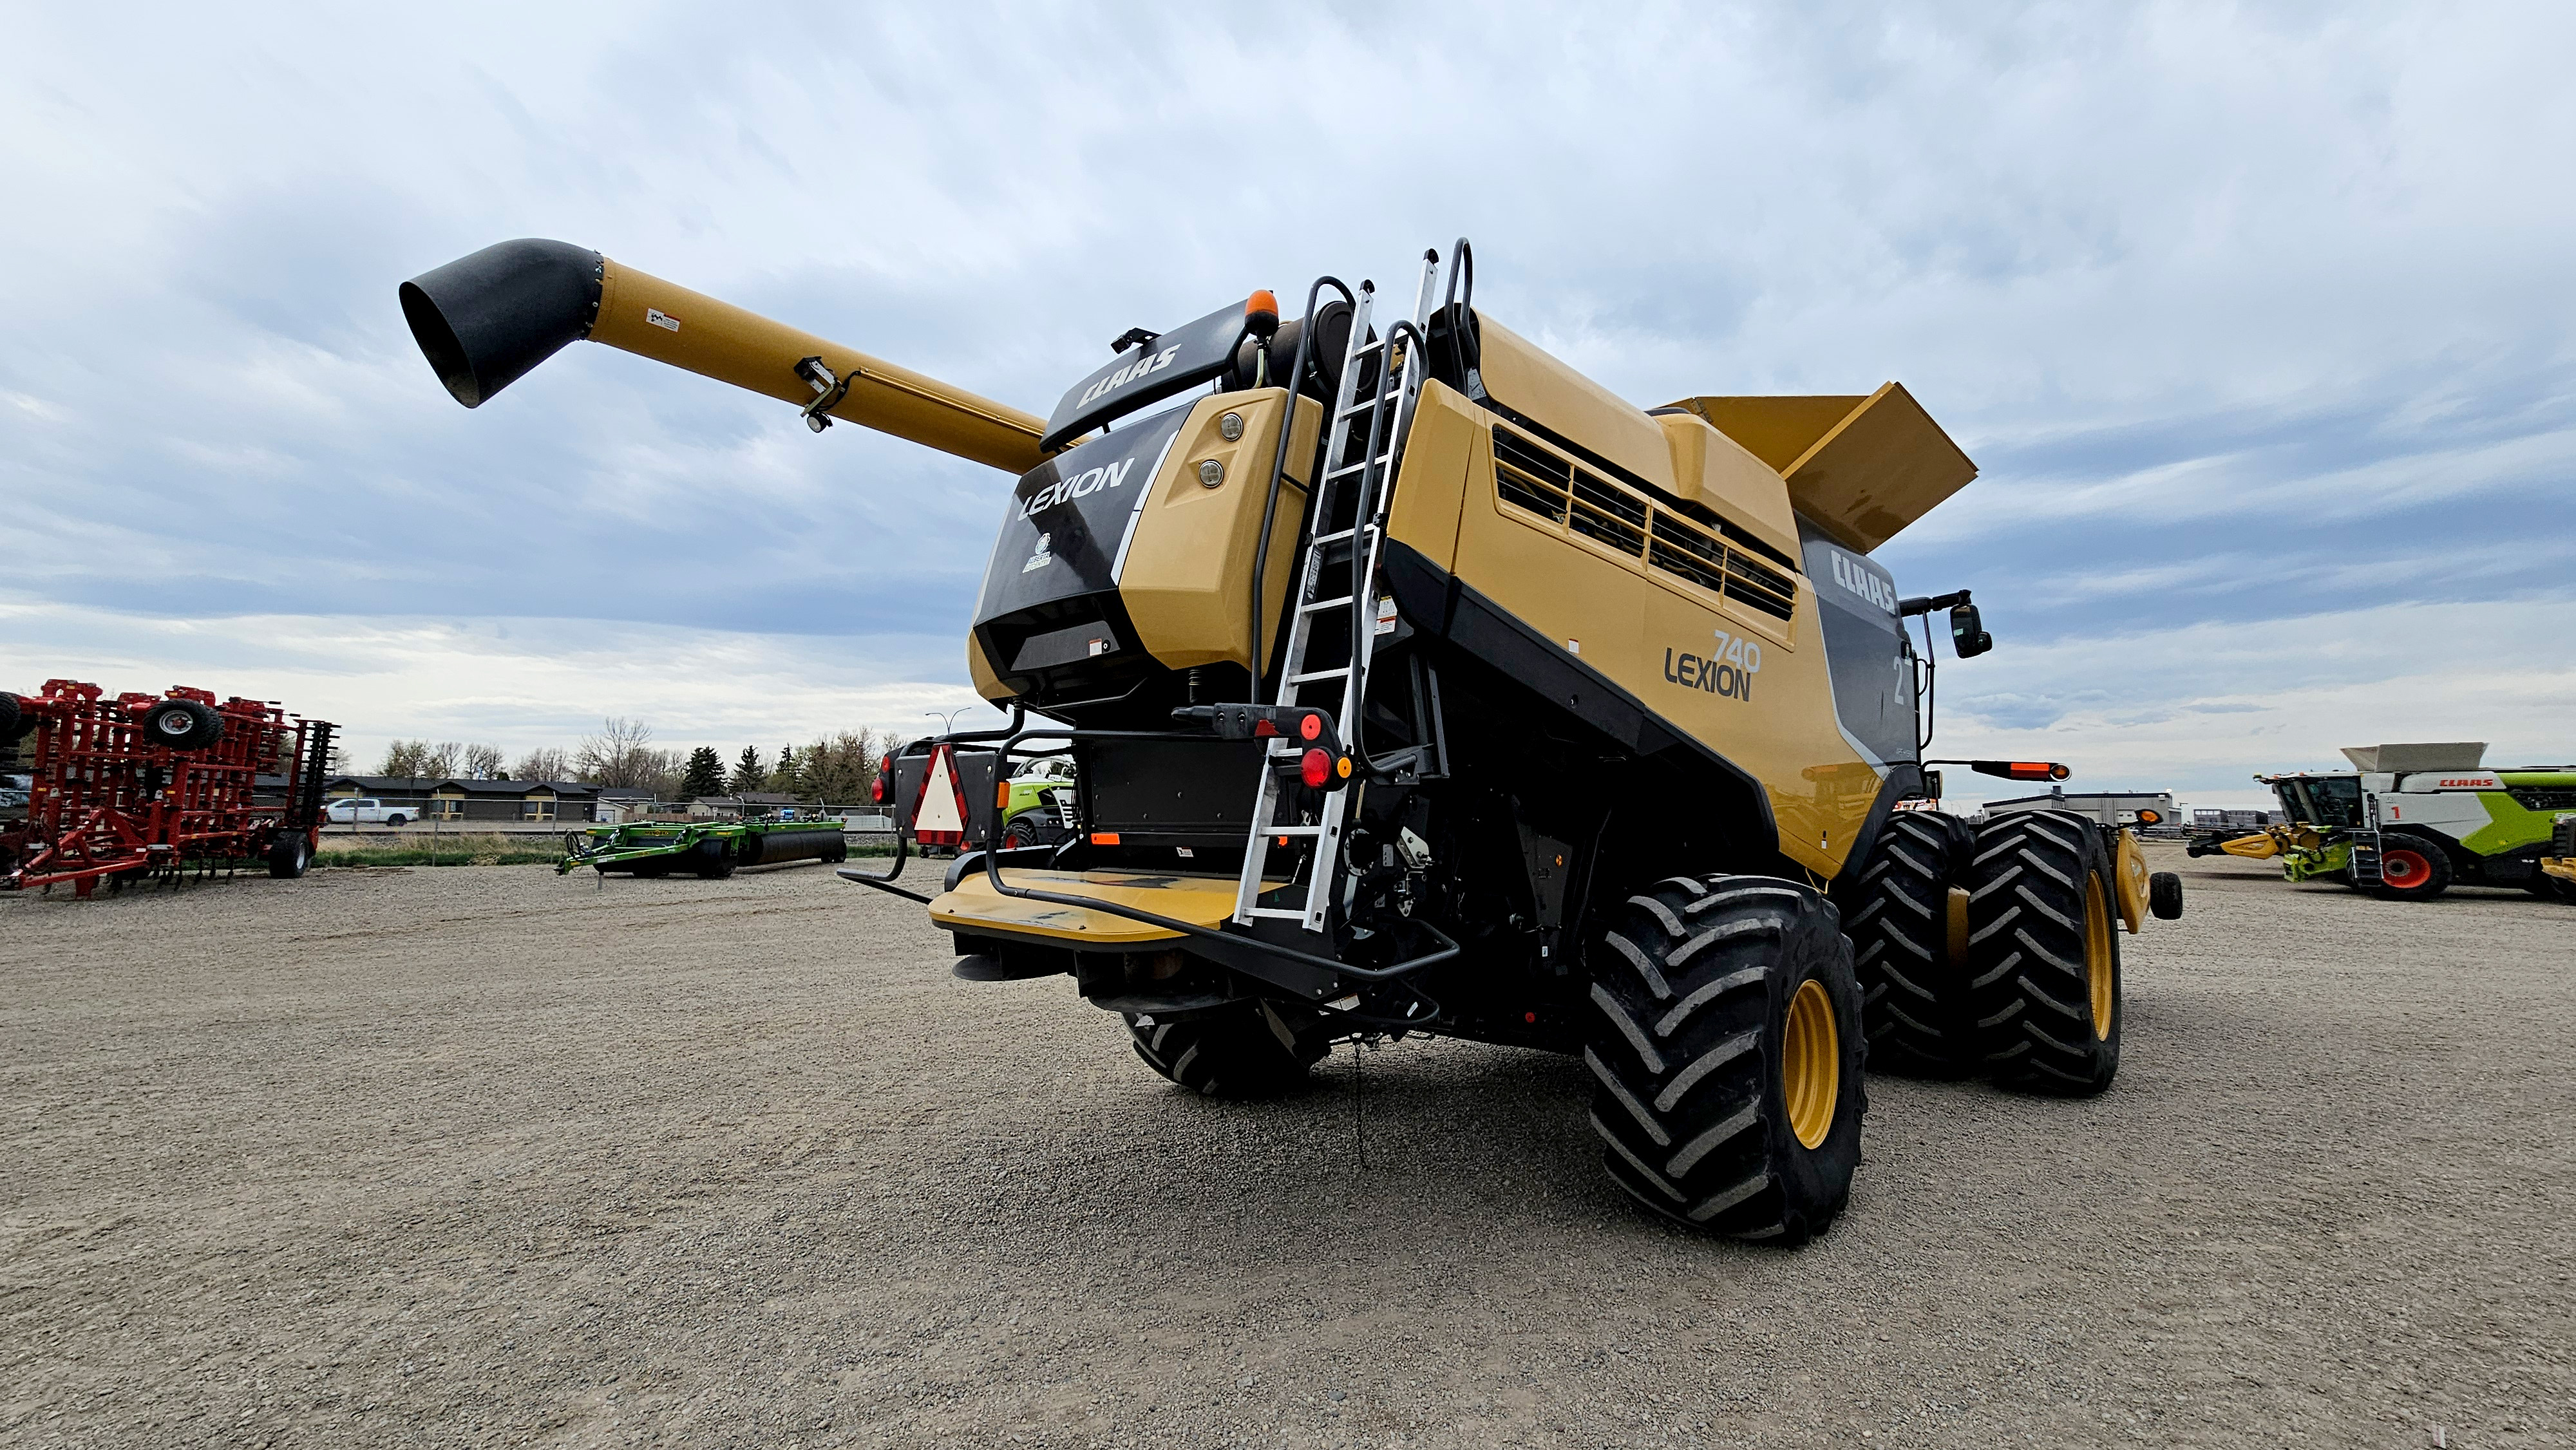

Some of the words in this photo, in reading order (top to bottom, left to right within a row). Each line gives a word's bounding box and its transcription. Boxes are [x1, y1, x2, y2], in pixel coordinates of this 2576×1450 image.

[1076, 343, 1182, 410] CLAAS
[1018, 457, 1135, 522] LEXION
[1831, 549, 1896, 616] CLAAS
[1664, 647, 1751, 702] LEXION
[1713, 629, 1761, 673] 740
[1893, 656, 1904, 706] 2
[2391, 806, 2401, 820] 1
